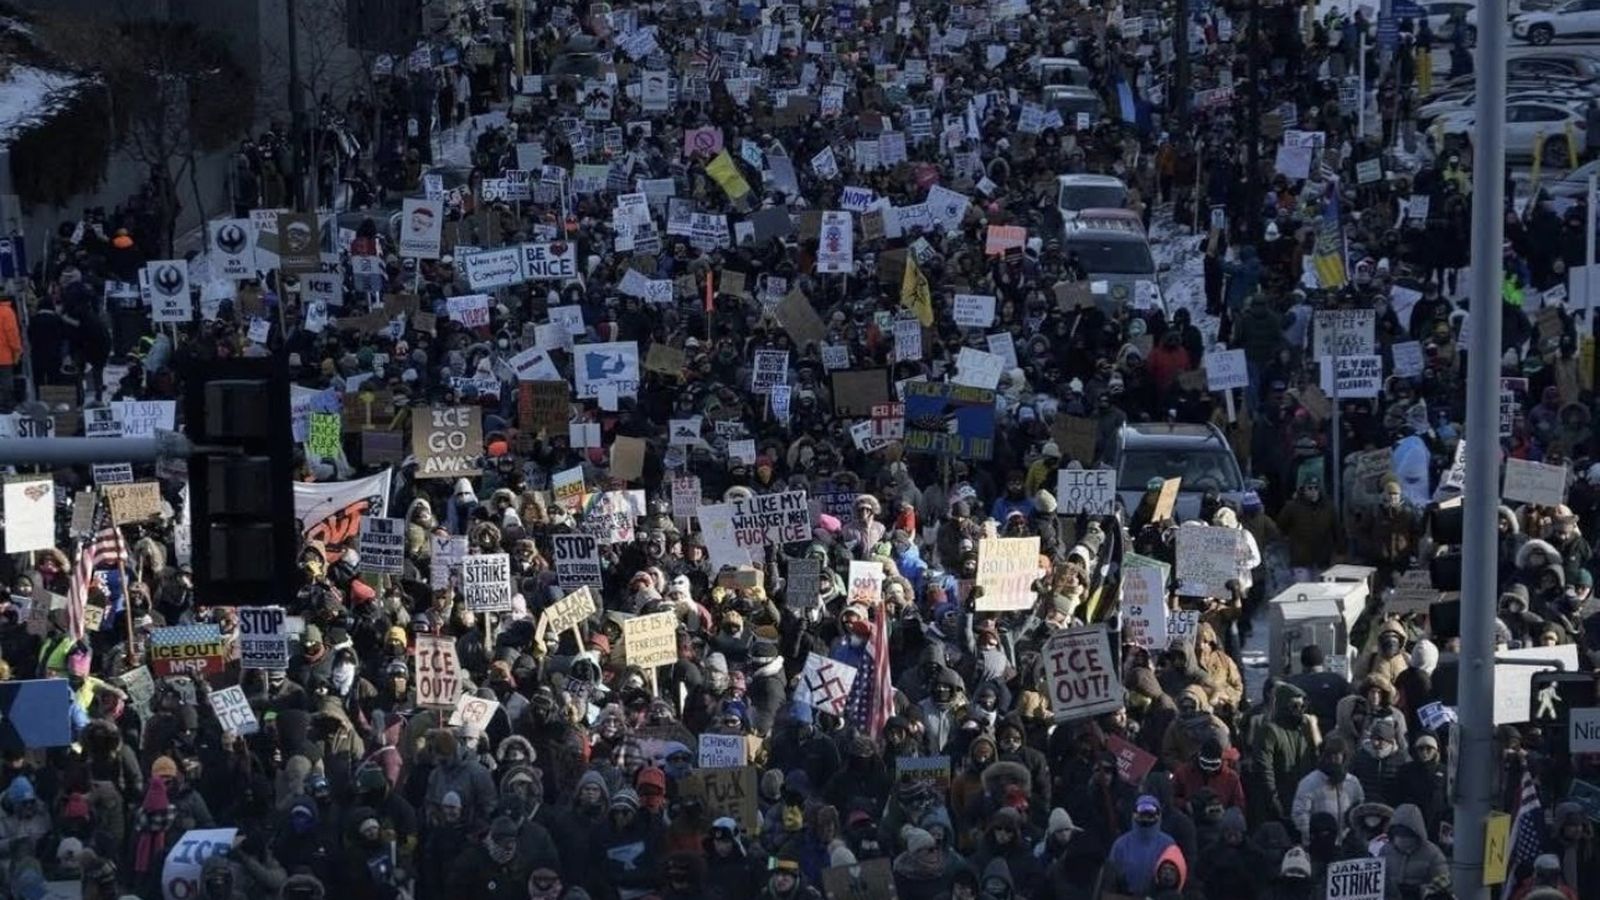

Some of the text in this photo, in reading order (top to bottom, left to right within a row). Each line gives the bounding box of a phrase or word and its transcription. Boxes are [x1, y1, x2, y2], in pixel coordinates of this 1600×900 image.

[507, 170, 529, 183] STOP
[526, 248, 545, 261] BE
[529, 259, 574, 275] NICE
[309, 281, 334, 293] ICE
[431, 407, 471, 427] ICE
[428, 431, 466, 452] GO
[1068, 471, 1107, 486] ICE
[733, 493, 804, 515] I LIKE MY
[1070, 486, 1107, 502] OUT
[732, 511, 785, 530] WHISKEY
[734, 524, 807, 548] FUCK ICE
[555, 536, 597, 561] STOP
[465, 564, 507, 584] STRIKE
[467, 587, 510, 605] RACISM
[240, 608, 284, 635] STOP
[628, 615, 679, 635] ICE IS A
[1170, 610, 1194, 621] ICE
[1167, 622, 1195, 635] OUT
[153, 642, 218, 659] ICE OUT
[170, 658, 208, 673] MSP
[418, 650, 455, 674] ICE
[1050, 648, 1103, 678] ICE
[210, 687, 245, 709] END
[419, 679, 457, 702] OUT!
[1055, 675, 1110, 704] OUT!
[219, 703, 256, 731] ICE
[1488, 836, 1506, 867] N
[1364, 862, 1382, 871] 23
[1329, 873, 1382, 898] STRIKE
